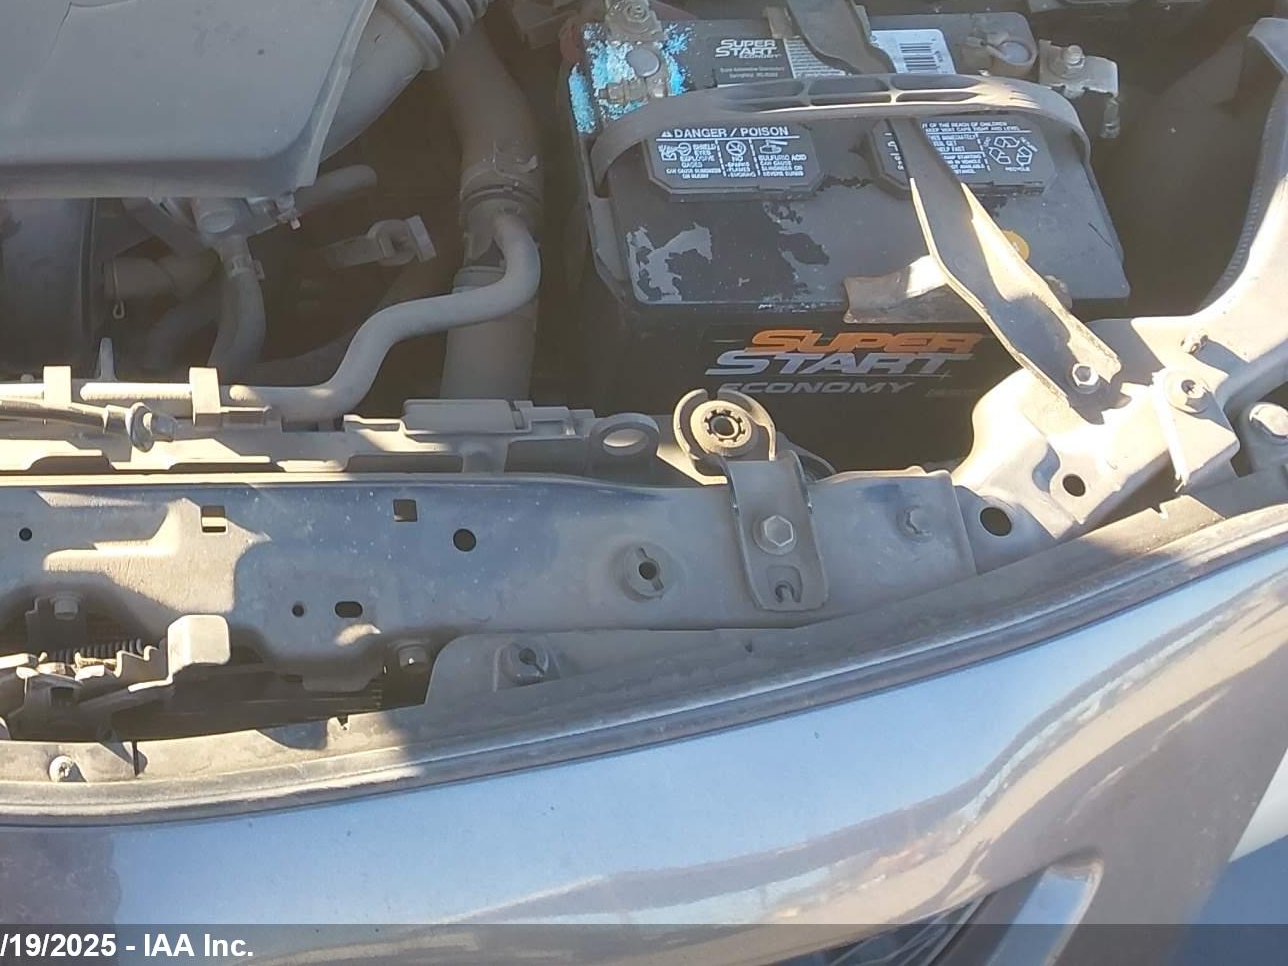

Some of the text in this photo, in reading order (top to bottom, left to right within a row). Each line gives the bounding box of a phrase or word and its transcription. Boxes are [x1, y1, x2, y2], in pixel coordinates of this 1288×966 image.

[720, 39, 776, 48] SUPER
[715, 46, 777, 59] START
[674, 128, 727, 138] DANGER
[740, 126, 788, 137] POISON
[744, 329, 982, 354] SUPER
[705, 349, 974, 375] START
[717, 382, 914, 395] ECONOMY
